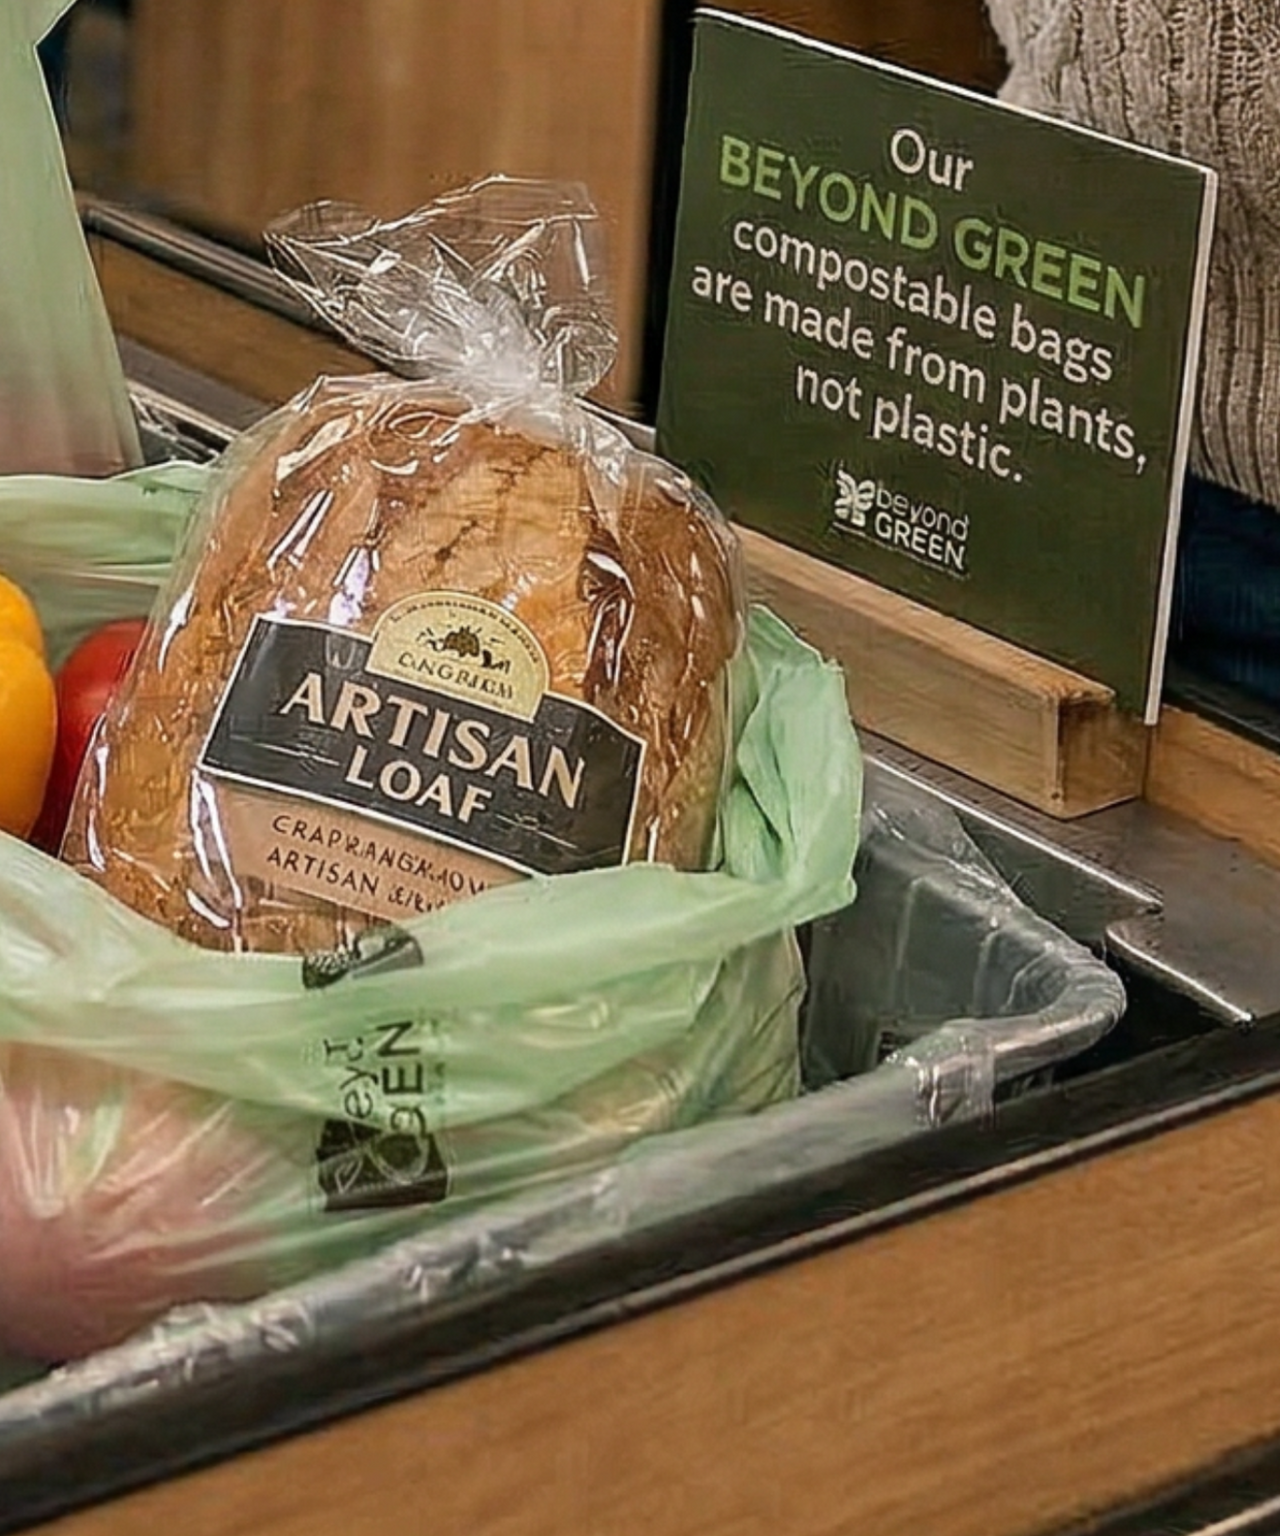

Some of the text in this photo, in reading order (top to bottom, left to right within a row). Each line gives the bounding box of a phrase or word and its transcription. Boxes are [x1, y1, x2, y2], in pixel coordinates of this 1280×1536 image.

[890, 127, 974, 192] Our
[718, 135, 1147, 330] BEYOND GREEN
[732, 219, 1114, 384] compostable bags
[690, 265, 1148, 476] are made from plants,
[796, 364, 1025, 484] not plastic.
[874, 511, 966, 571] GREEN
[875, 481, 970, 542] beyond
[280, 671, 586, 810] ARTISAN
[345, 744, 493, 824] LOAF
[266, 846, 380, 898] ARTISAN
